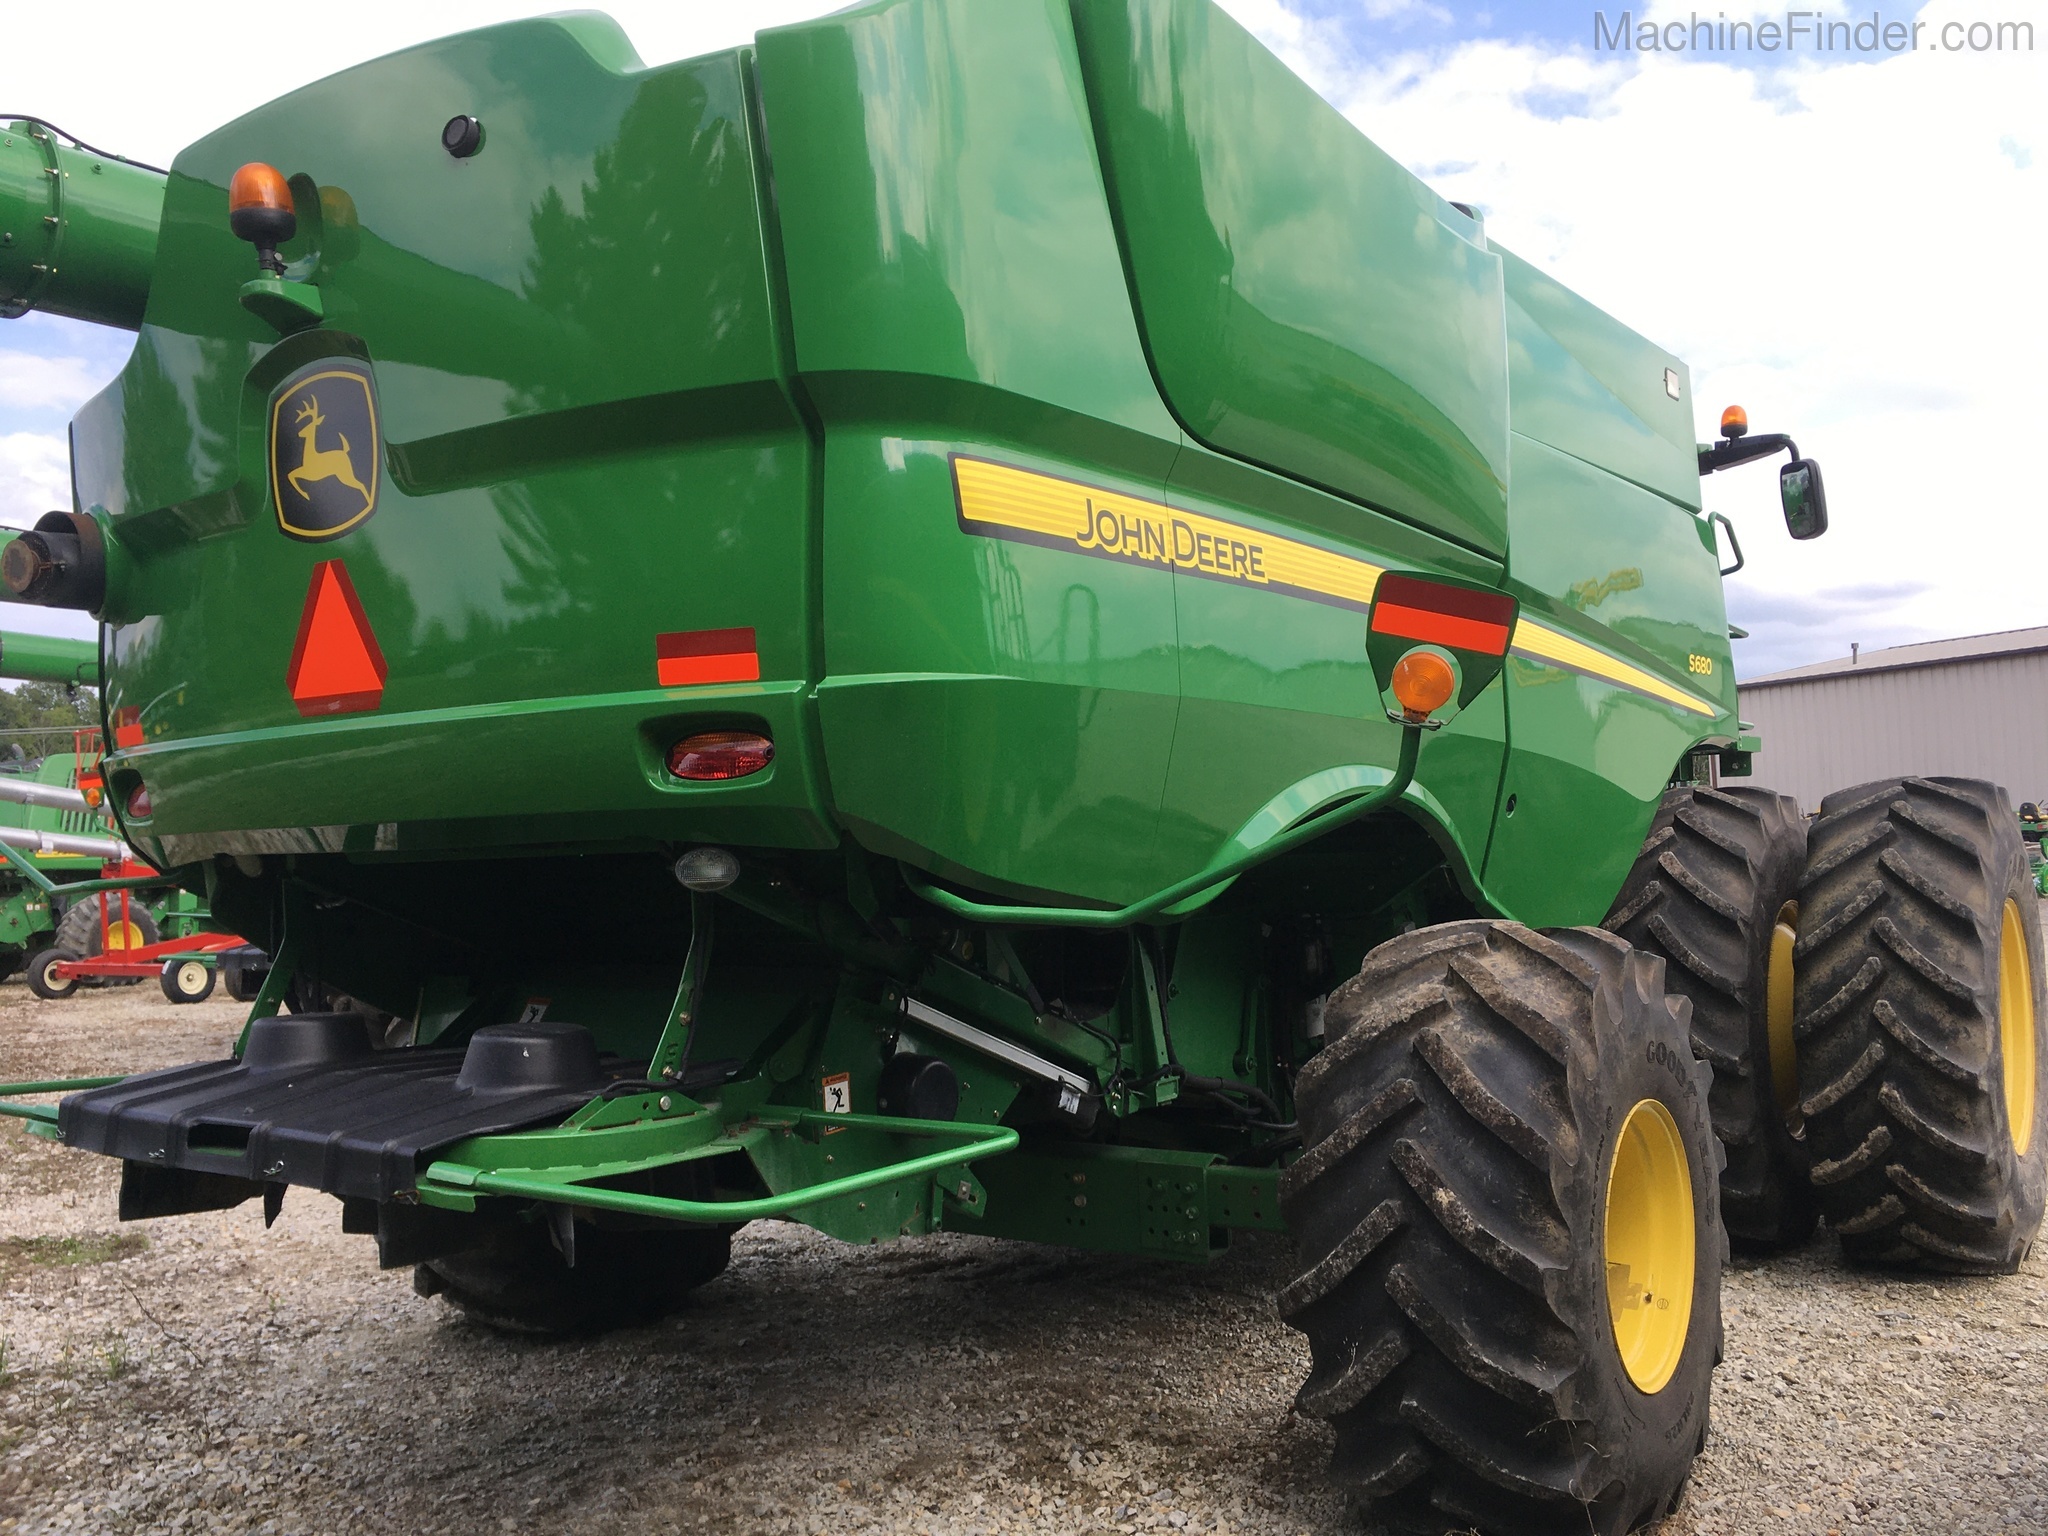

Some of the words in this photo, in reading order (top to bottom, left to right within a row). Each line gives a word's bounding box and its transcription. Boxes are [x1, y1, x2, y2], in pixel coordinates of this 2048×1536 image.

[1076, 497, 1166, 561] JOHN
[1170, 518, 1268, 581] DEERE
[1689, 653, 1713, 676] S680
